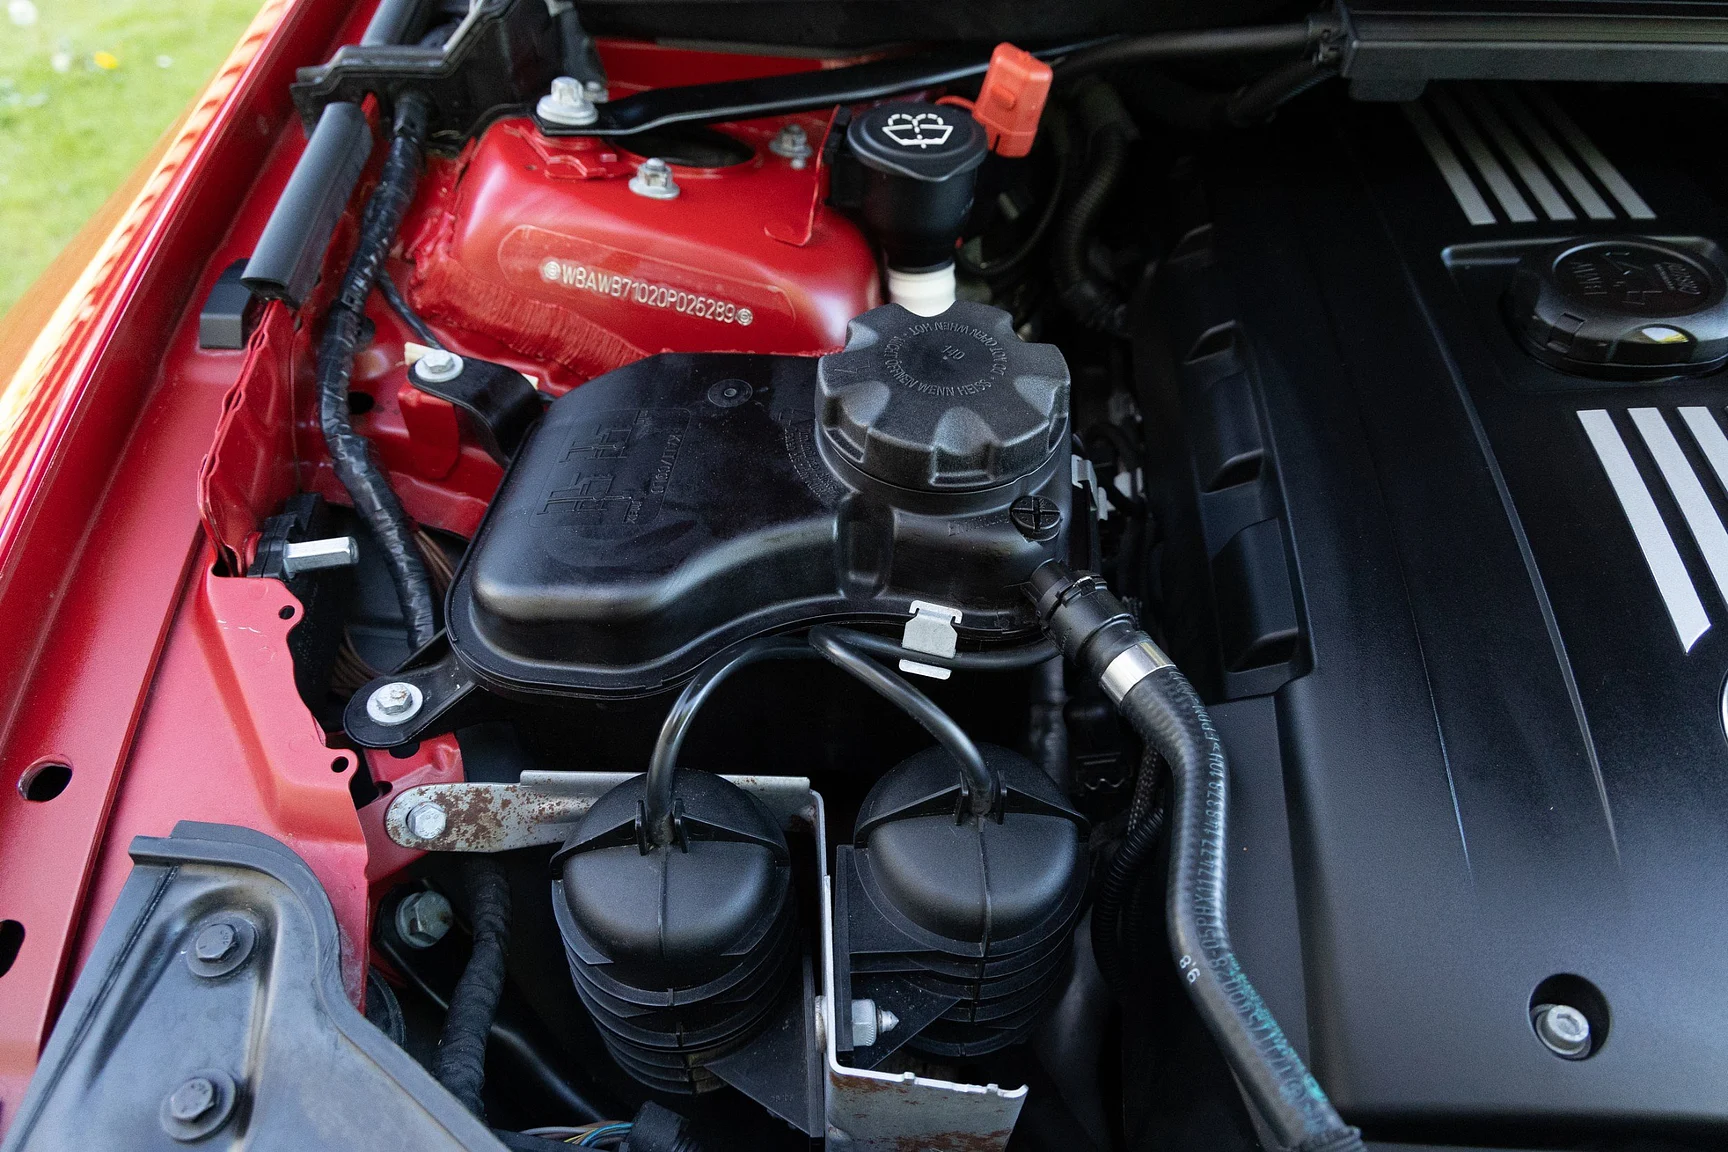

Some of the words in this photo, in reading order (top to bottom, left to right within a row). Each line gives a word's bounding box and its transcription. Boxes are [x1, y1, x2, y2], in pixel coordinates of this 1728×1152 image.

[562, 264, 735, 323] WBAWB71020P026289
[908, 322, 932, 336] HOT
[934, 321, 969, 334] WHEN
[969, 328, 998, 347] OPEN
[989, 347, 1008, 363] NOT
[917, 382, 955, 396] WENN
[956, 379, 992, 396] HEISS
